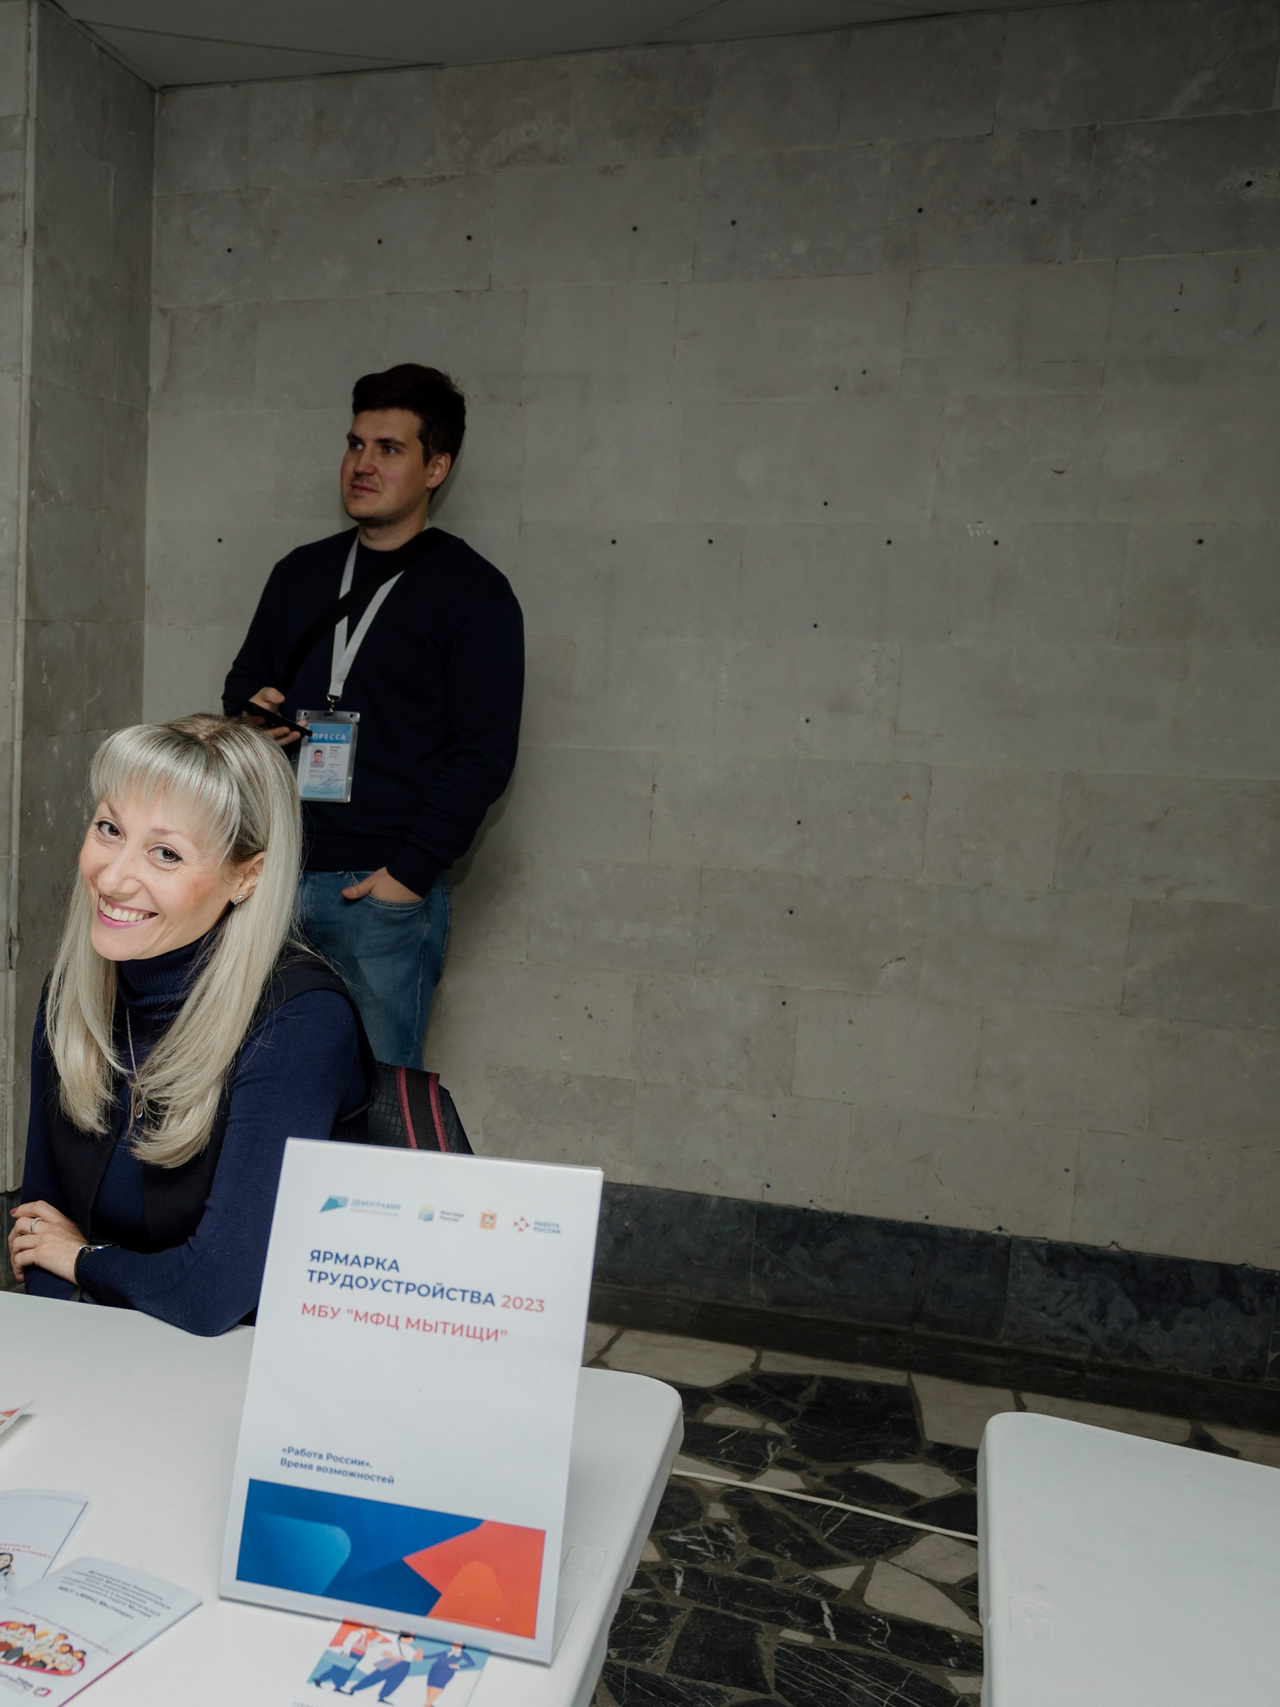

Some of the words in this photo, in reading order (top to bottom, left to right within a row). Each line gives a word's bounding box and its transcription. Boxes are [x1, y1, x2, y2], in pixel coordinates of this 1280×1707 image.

[312, 732, 347, 741] ПРЕССА
[309, 1249, 400, 1273] ЯРМАРКА
[307, 1269, 496, 1307] ТРУДОУСТРОЙСТВА
[501, 1294, 545, 1313] 2023
[301, 1303, 341, 1320] МБУ
[346, 1308, 400, 1330] "МФЦ
[405, 1318, 508, 1342] МЫТИЩИ"
[282, 1446, 323, 1460] «Работа
[280, 1458, 314, 1472] Время
[316, 1465, 395, 1485] возможностей
